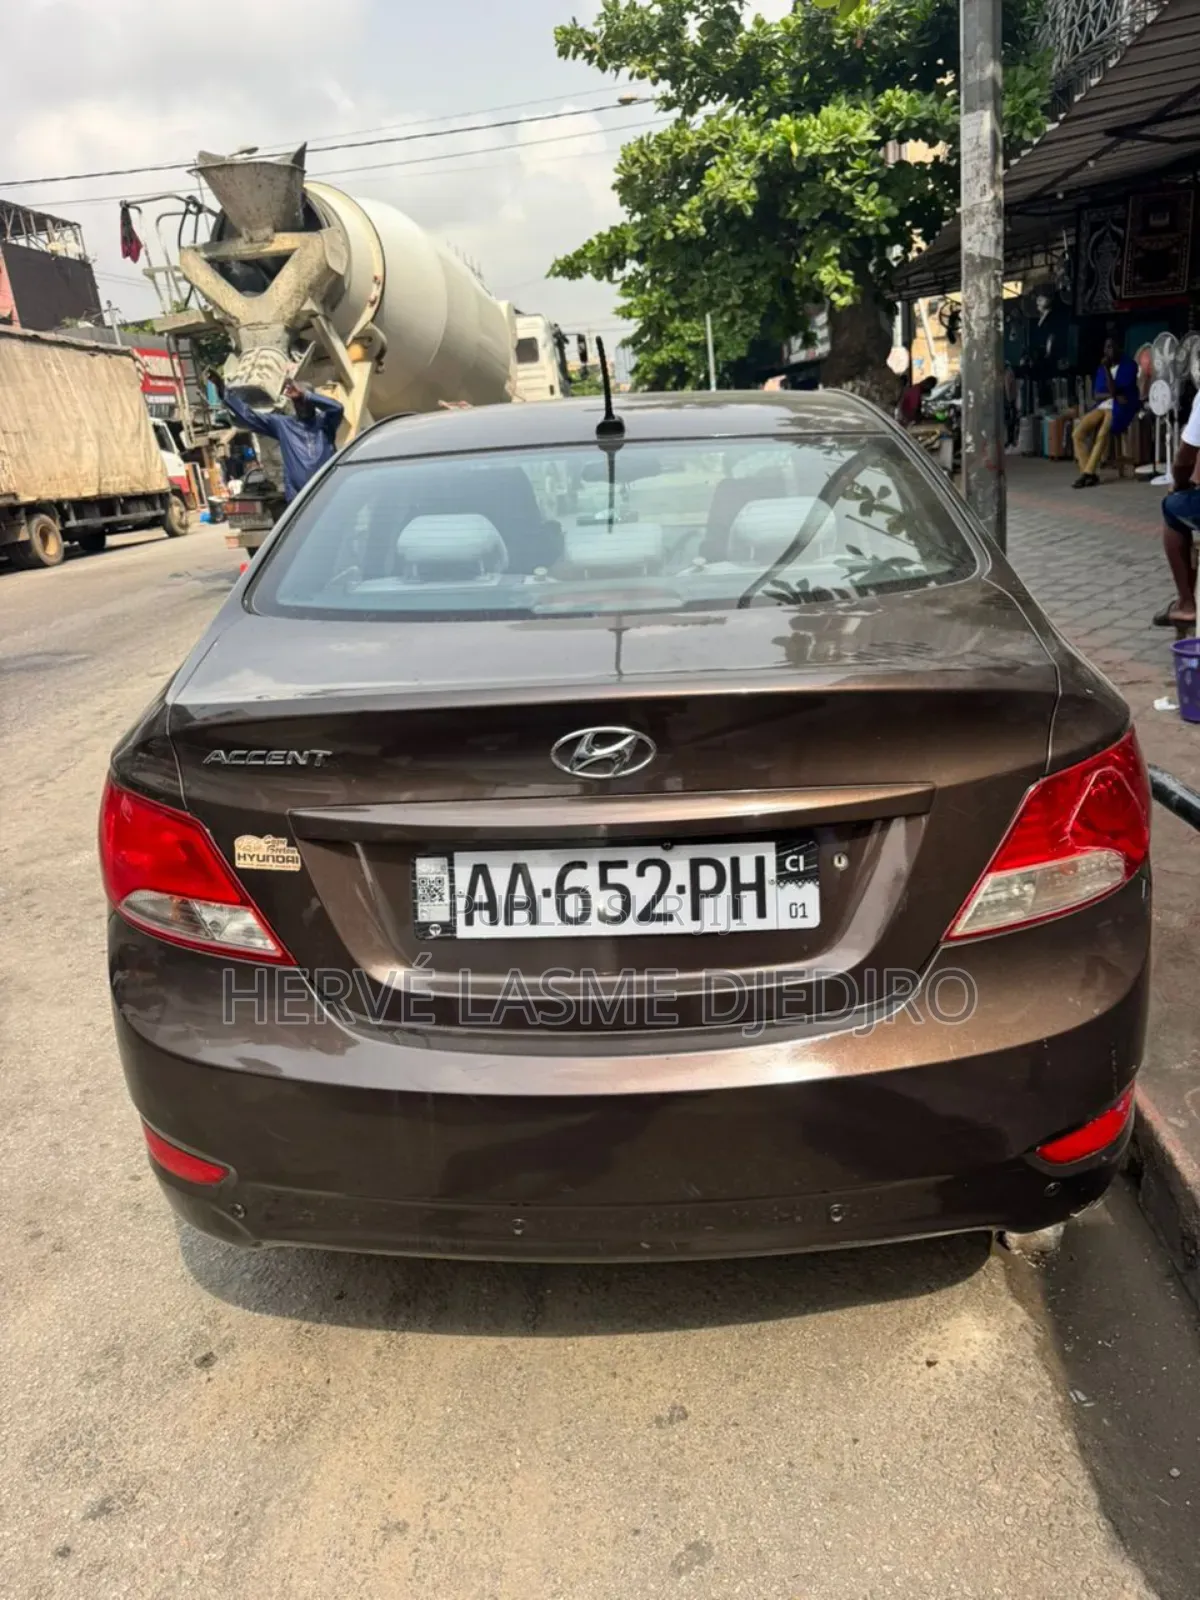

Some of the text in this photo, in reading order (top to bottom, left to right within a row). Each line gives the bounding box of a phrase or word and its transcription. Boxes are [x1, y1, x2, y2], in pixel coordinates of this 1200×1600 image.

[202, 749, 333, 767] ACCENT
[237, 853, 299, 864] HYUNDAI
[785, 855, 805, 872] CI
[789, 902, 809, 918] 01
